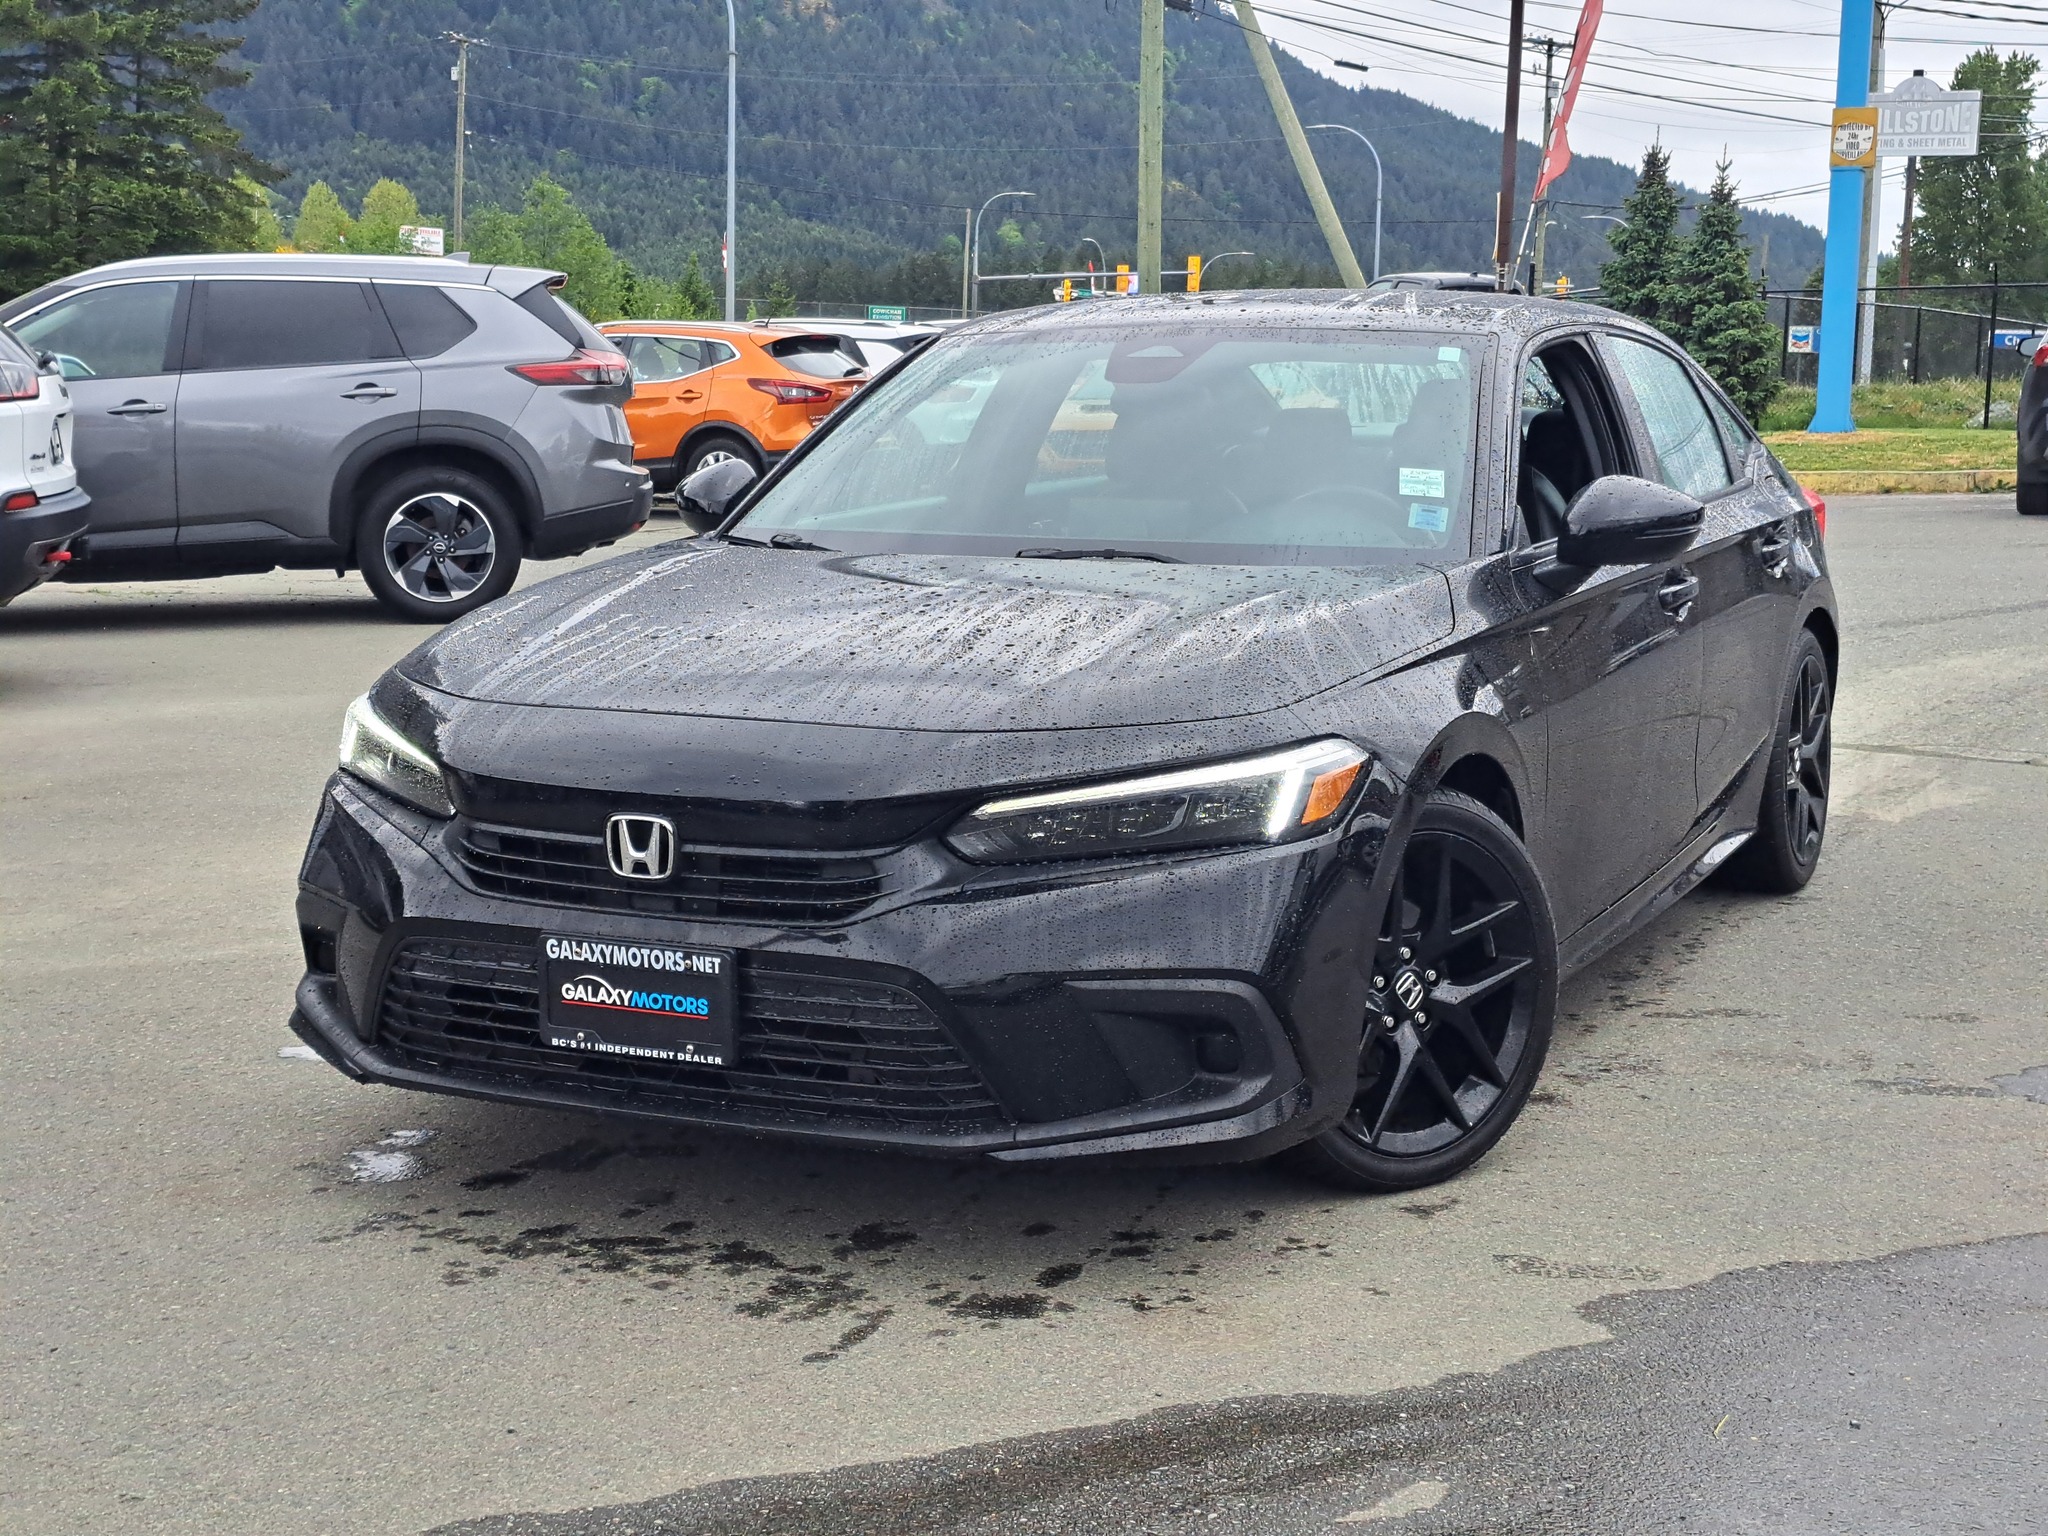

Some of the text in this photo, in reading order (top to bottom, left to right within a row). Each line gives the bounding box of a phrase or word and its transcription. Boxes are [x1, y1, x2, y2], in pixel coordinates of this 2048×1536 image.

[1838, 122, 1864, 131] ROTECTED
[1848, 132, 1859, 140] 24hr
[1846, 141, 1860, 150] VIDEO
[1898, 138, 1905, 148] &
[1907, 137, 1935, 148] SHEET
[1938, 137, 1967, 147] METAL
[551, 1038, 577, 1049] BC'S
[595, 1043, 675, 1060] INDEPENDENT
[677, 1052, 722, 1066] DEALER
